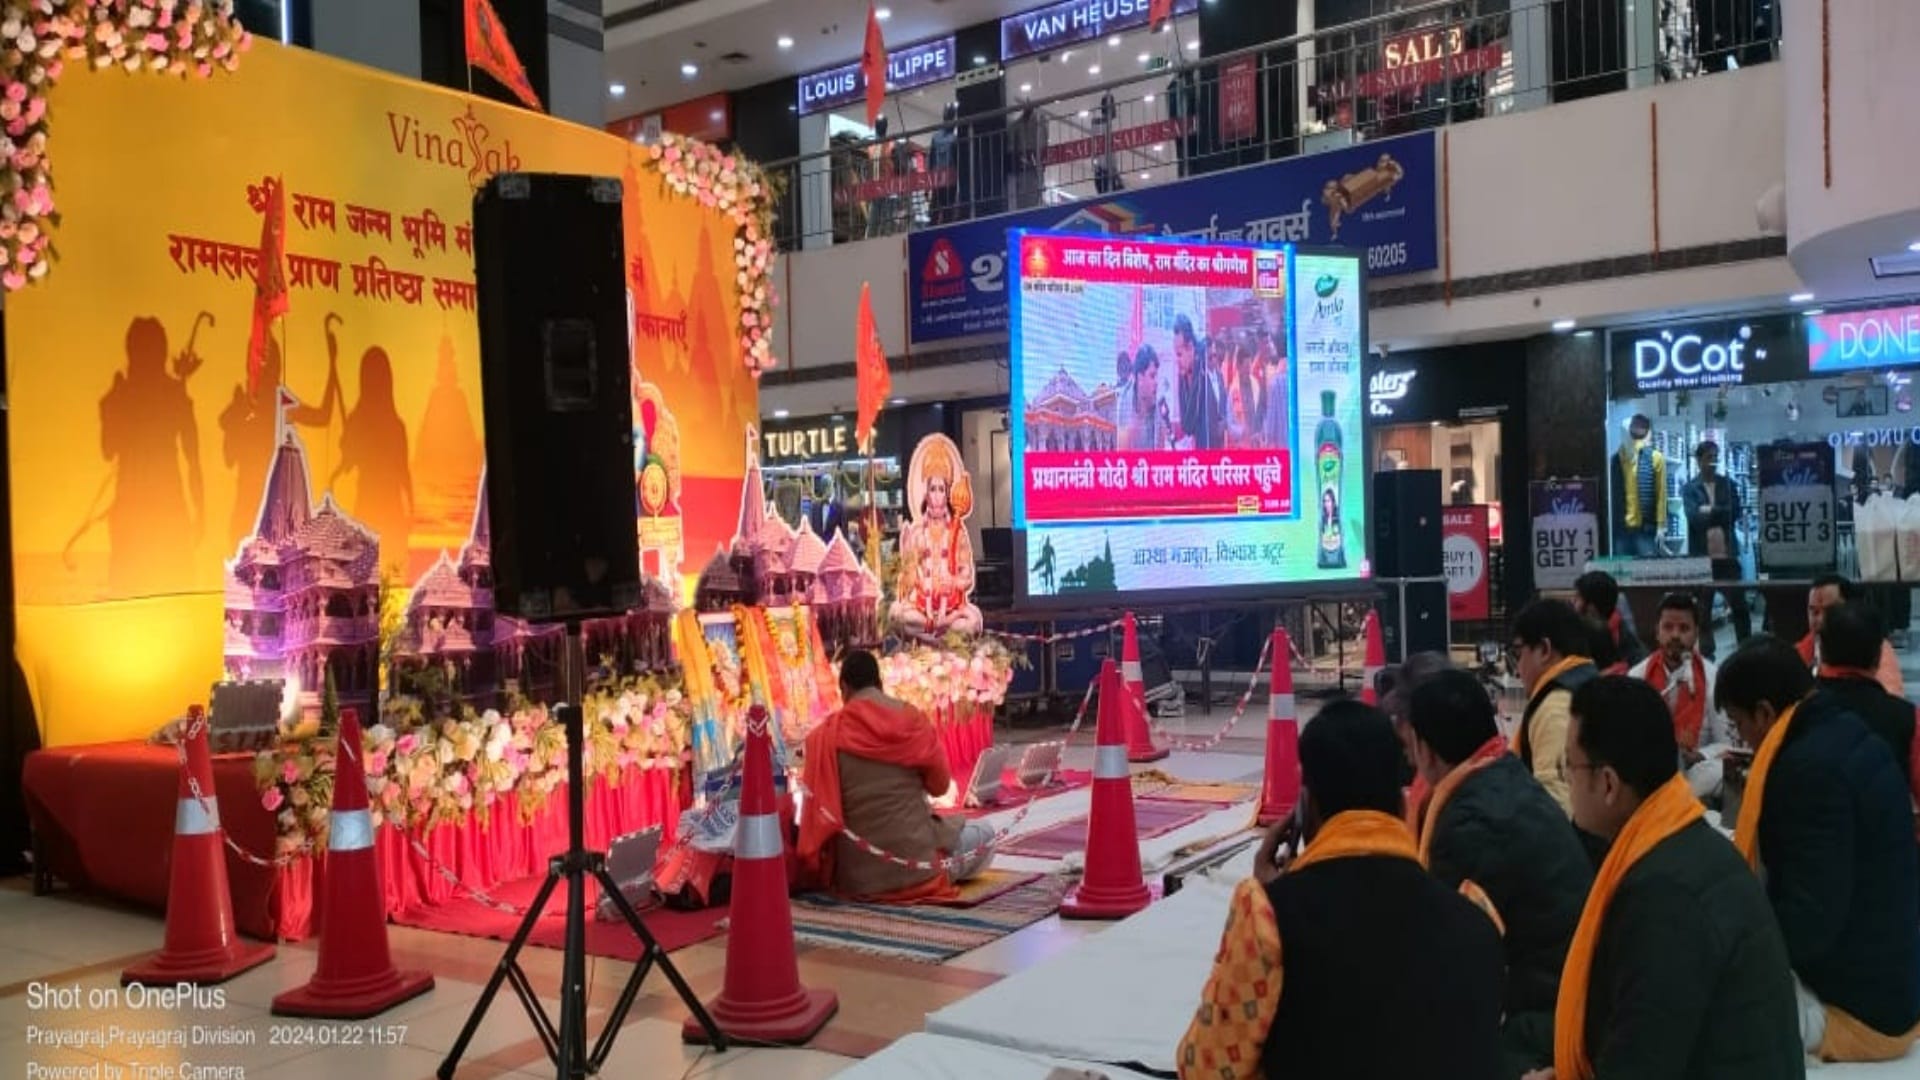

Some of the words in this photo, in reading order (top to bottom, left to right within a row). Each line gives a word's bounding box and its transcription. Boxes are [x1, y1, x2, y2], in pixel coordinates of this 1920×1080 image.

[1025, 16, 1066, 42] VAN
[1072, 0, 1150, 29] HEUSE
[1385, 27, 1463, 69] SALE
[804, 75, 856, 101] LOUIS
[864, 48, 947, 88] ILIPPE
[1376, 65, 1425, 88] SALE
[1113, 127, 1152, 150] SALE
[292, 193, 337, 232] राम
[345, 204, 392, 242] जन्म
[402, 208, 447, 259] भूमि
[1063, 248, 1085, 267] आज
[1088, 249, 1101, 267] का
[1103, 245, 1120, 269] दिन
[1154, 253, 1171, 271] राम
[1173, 249, 1195, 273] मंदिर
[1196, 256, 1210, 272] का
[1367, 242, 1407, 270] 60205
[285, 253, 342, 293] प्राण
[764, 426, 848, 459] TURTLE
[1032, 458, 1096, 490] प्रधानमंत्री
[1096, 458, 1128, 489] मोदी
[1131, 457, 1149, 488] श्री
[1152, 464, 1174, 487] राम
[1178, 457, 1208, 487] मंदिर
[1211, 456, 1251, 487] परिसर
[1764, 501, 1811, 522] BUY
[1819, 502, 1828, 519] 1
[1536, 528, 1578, 548] BUY
[1584, 529, 1594, 546] 1
[1764, 523, 1812, 543] GET
[1818, 522, 1830, 542] 3
[1536, 549, 1578, 568] GET
